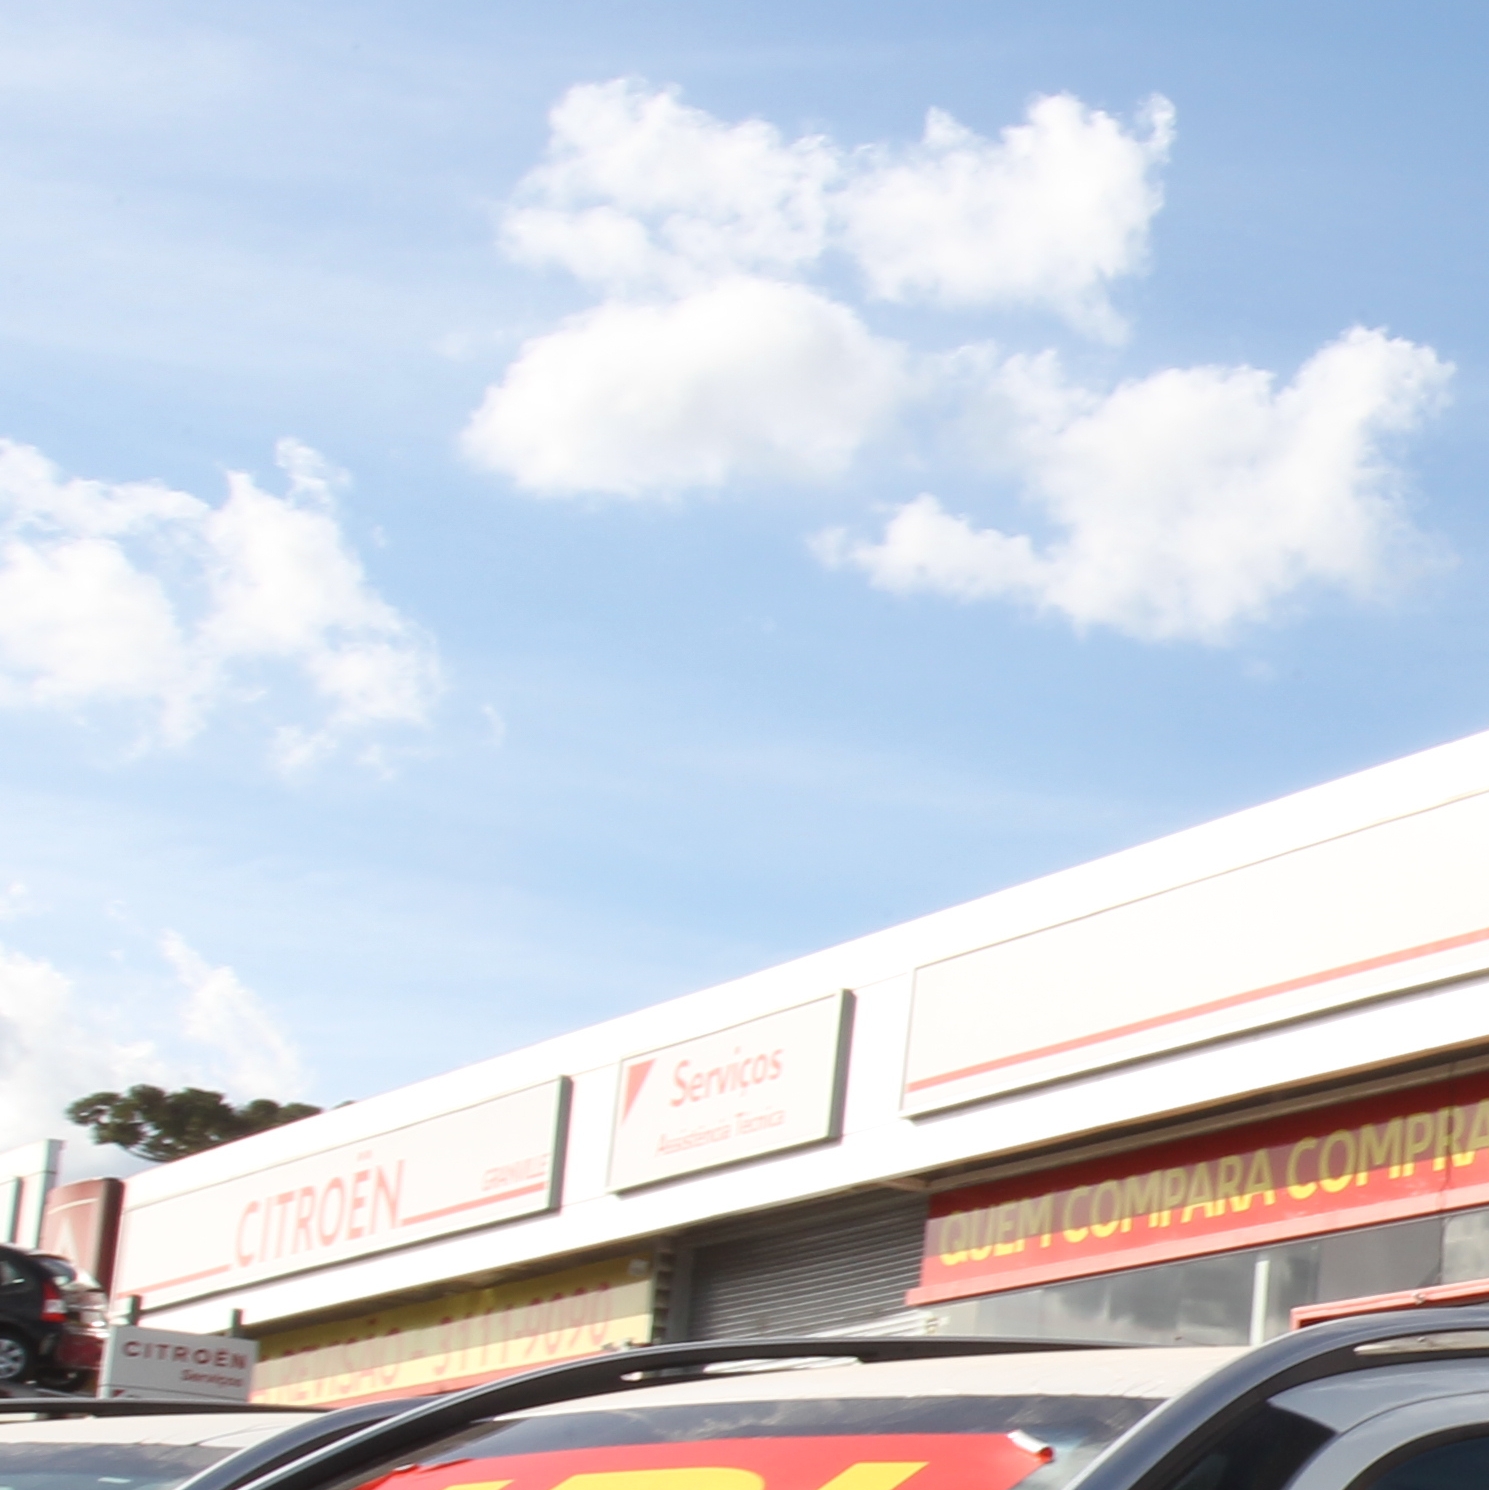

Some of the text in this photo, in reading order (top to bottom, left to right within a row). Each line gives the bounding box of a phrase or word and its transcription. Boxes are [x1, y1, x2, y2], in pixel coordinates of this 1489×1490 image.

[669, 1046, 784, 1107] Serviços
[233, 1149, 406, 1268] CITROËN
[938, 1199, 1053, 1267] QUEM
[1062, 1147, 1276, 1243] COMPARA
[433, 1281, 614, 1377] 3111-9090
